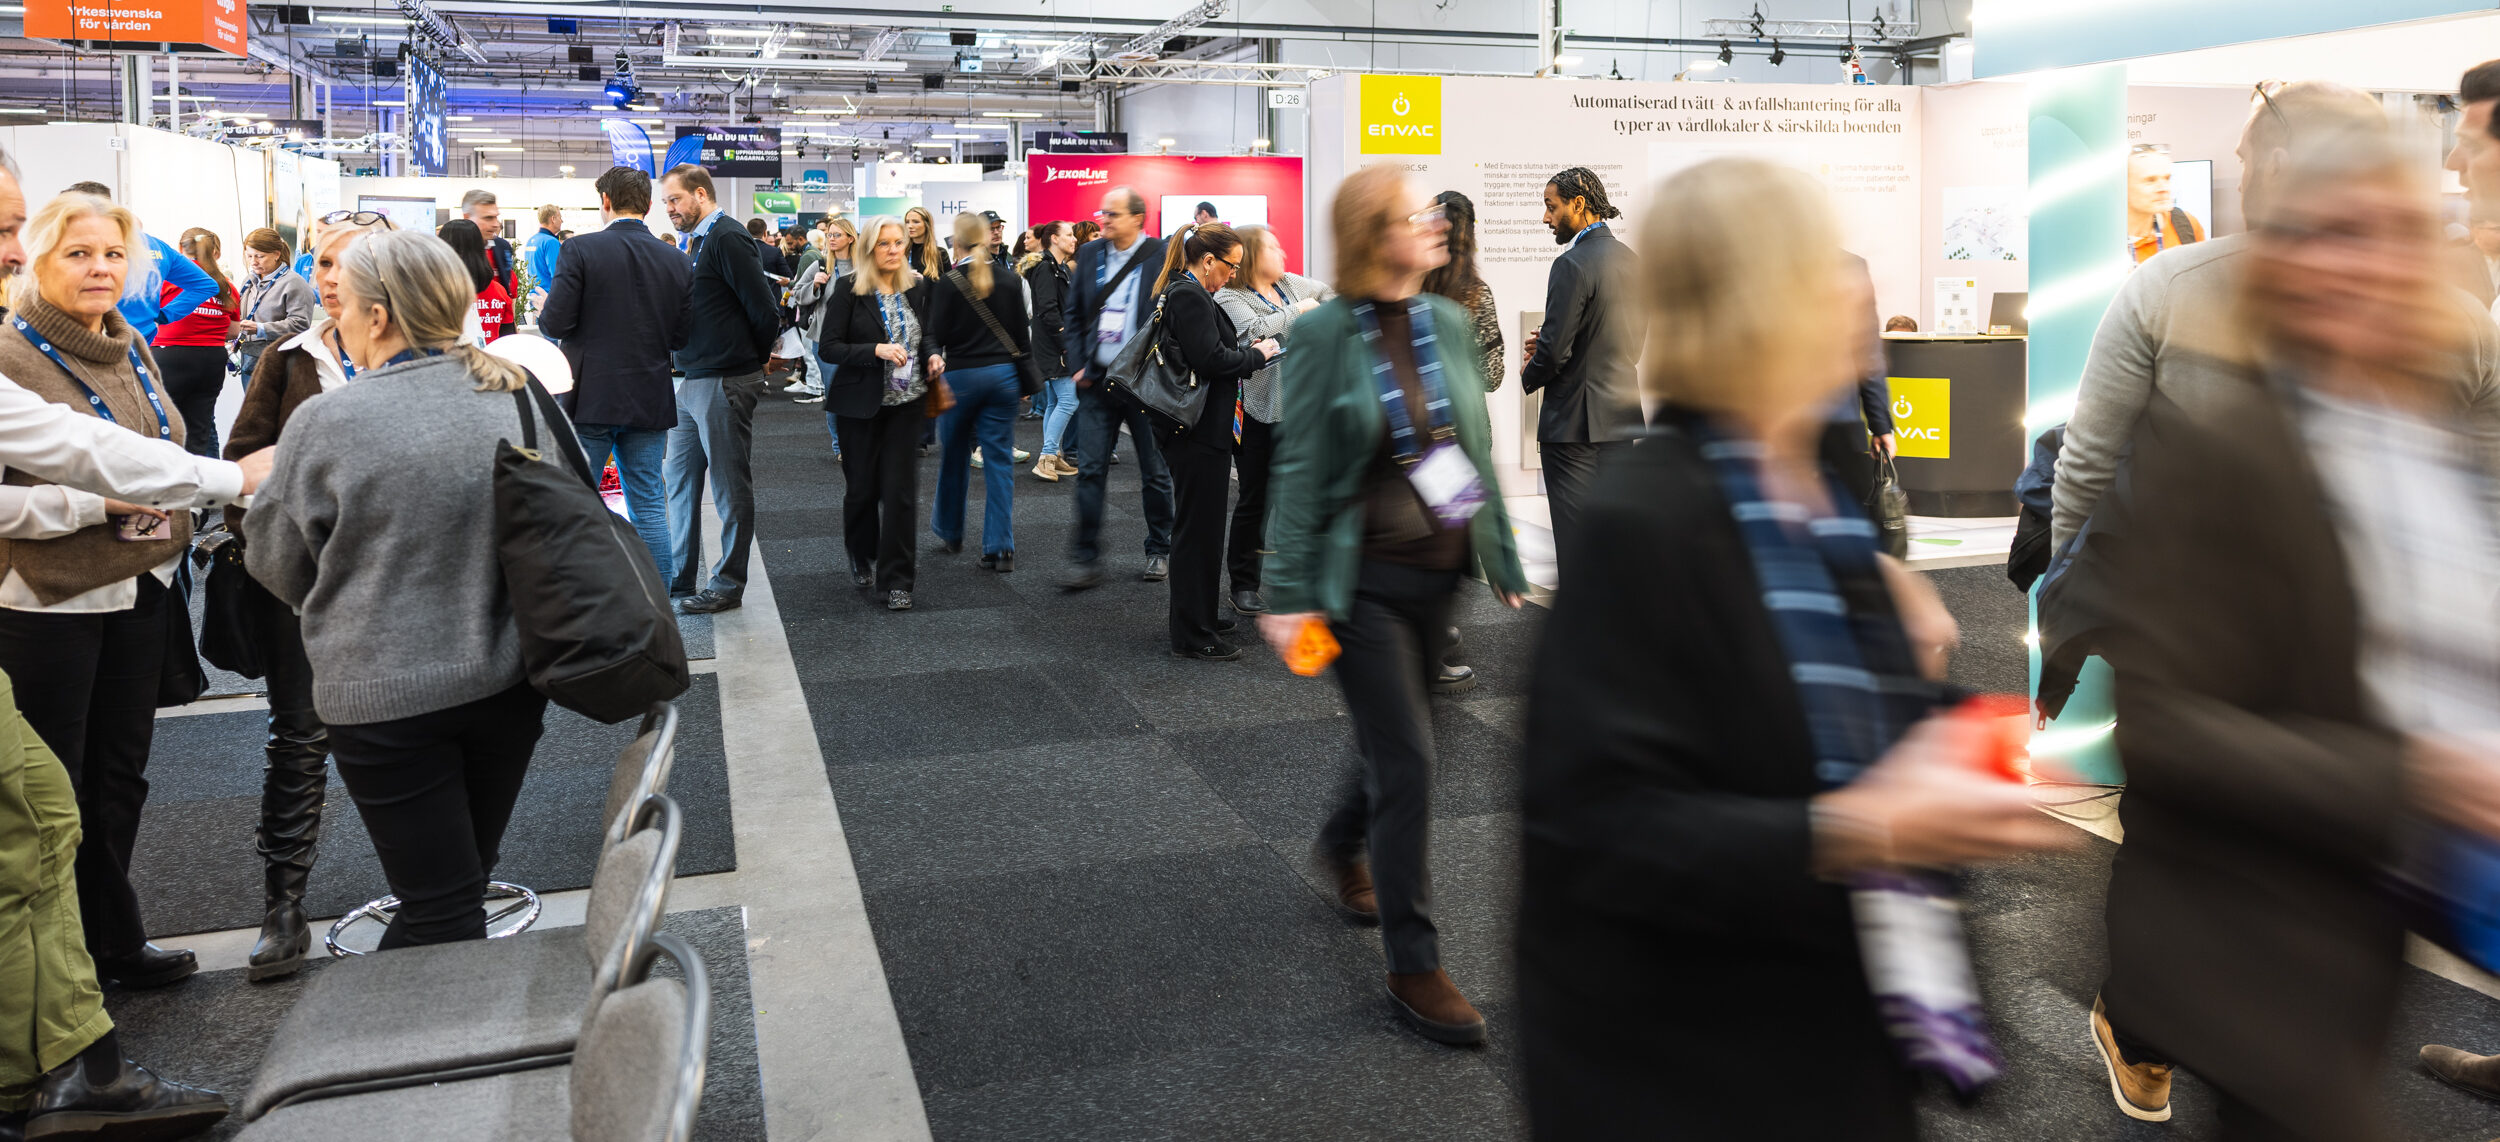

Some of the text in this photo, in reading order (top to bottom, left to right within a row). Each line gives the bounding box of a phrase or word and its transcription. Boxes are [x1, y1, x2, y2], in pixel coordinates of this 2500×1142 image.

[68, 6, 162, 20] Yrkessvenska
[80, 18, 151, 31] för vården
[1275, 94, 1300, 105] D:26
[1570, 94, 1902, 115] Automatiserad tvätt- & avfallshantering för alla
[2128, 112, 2157, 125] ningar
[1368, 124, 1434, 137] ENVAC
[1614, 116, 1902, 135] typer av vårdlokaler & särskilda boenden
[1062, 138, 1077, 146] GÅR
[1524, 162, 1544, 170] slutna
[1518, 172, 1554, 180] smittsprid
[490, 298, 506, 310] för
[192, 306, 223, 316] emma
[1868, 426, 1940, 440] VAC
